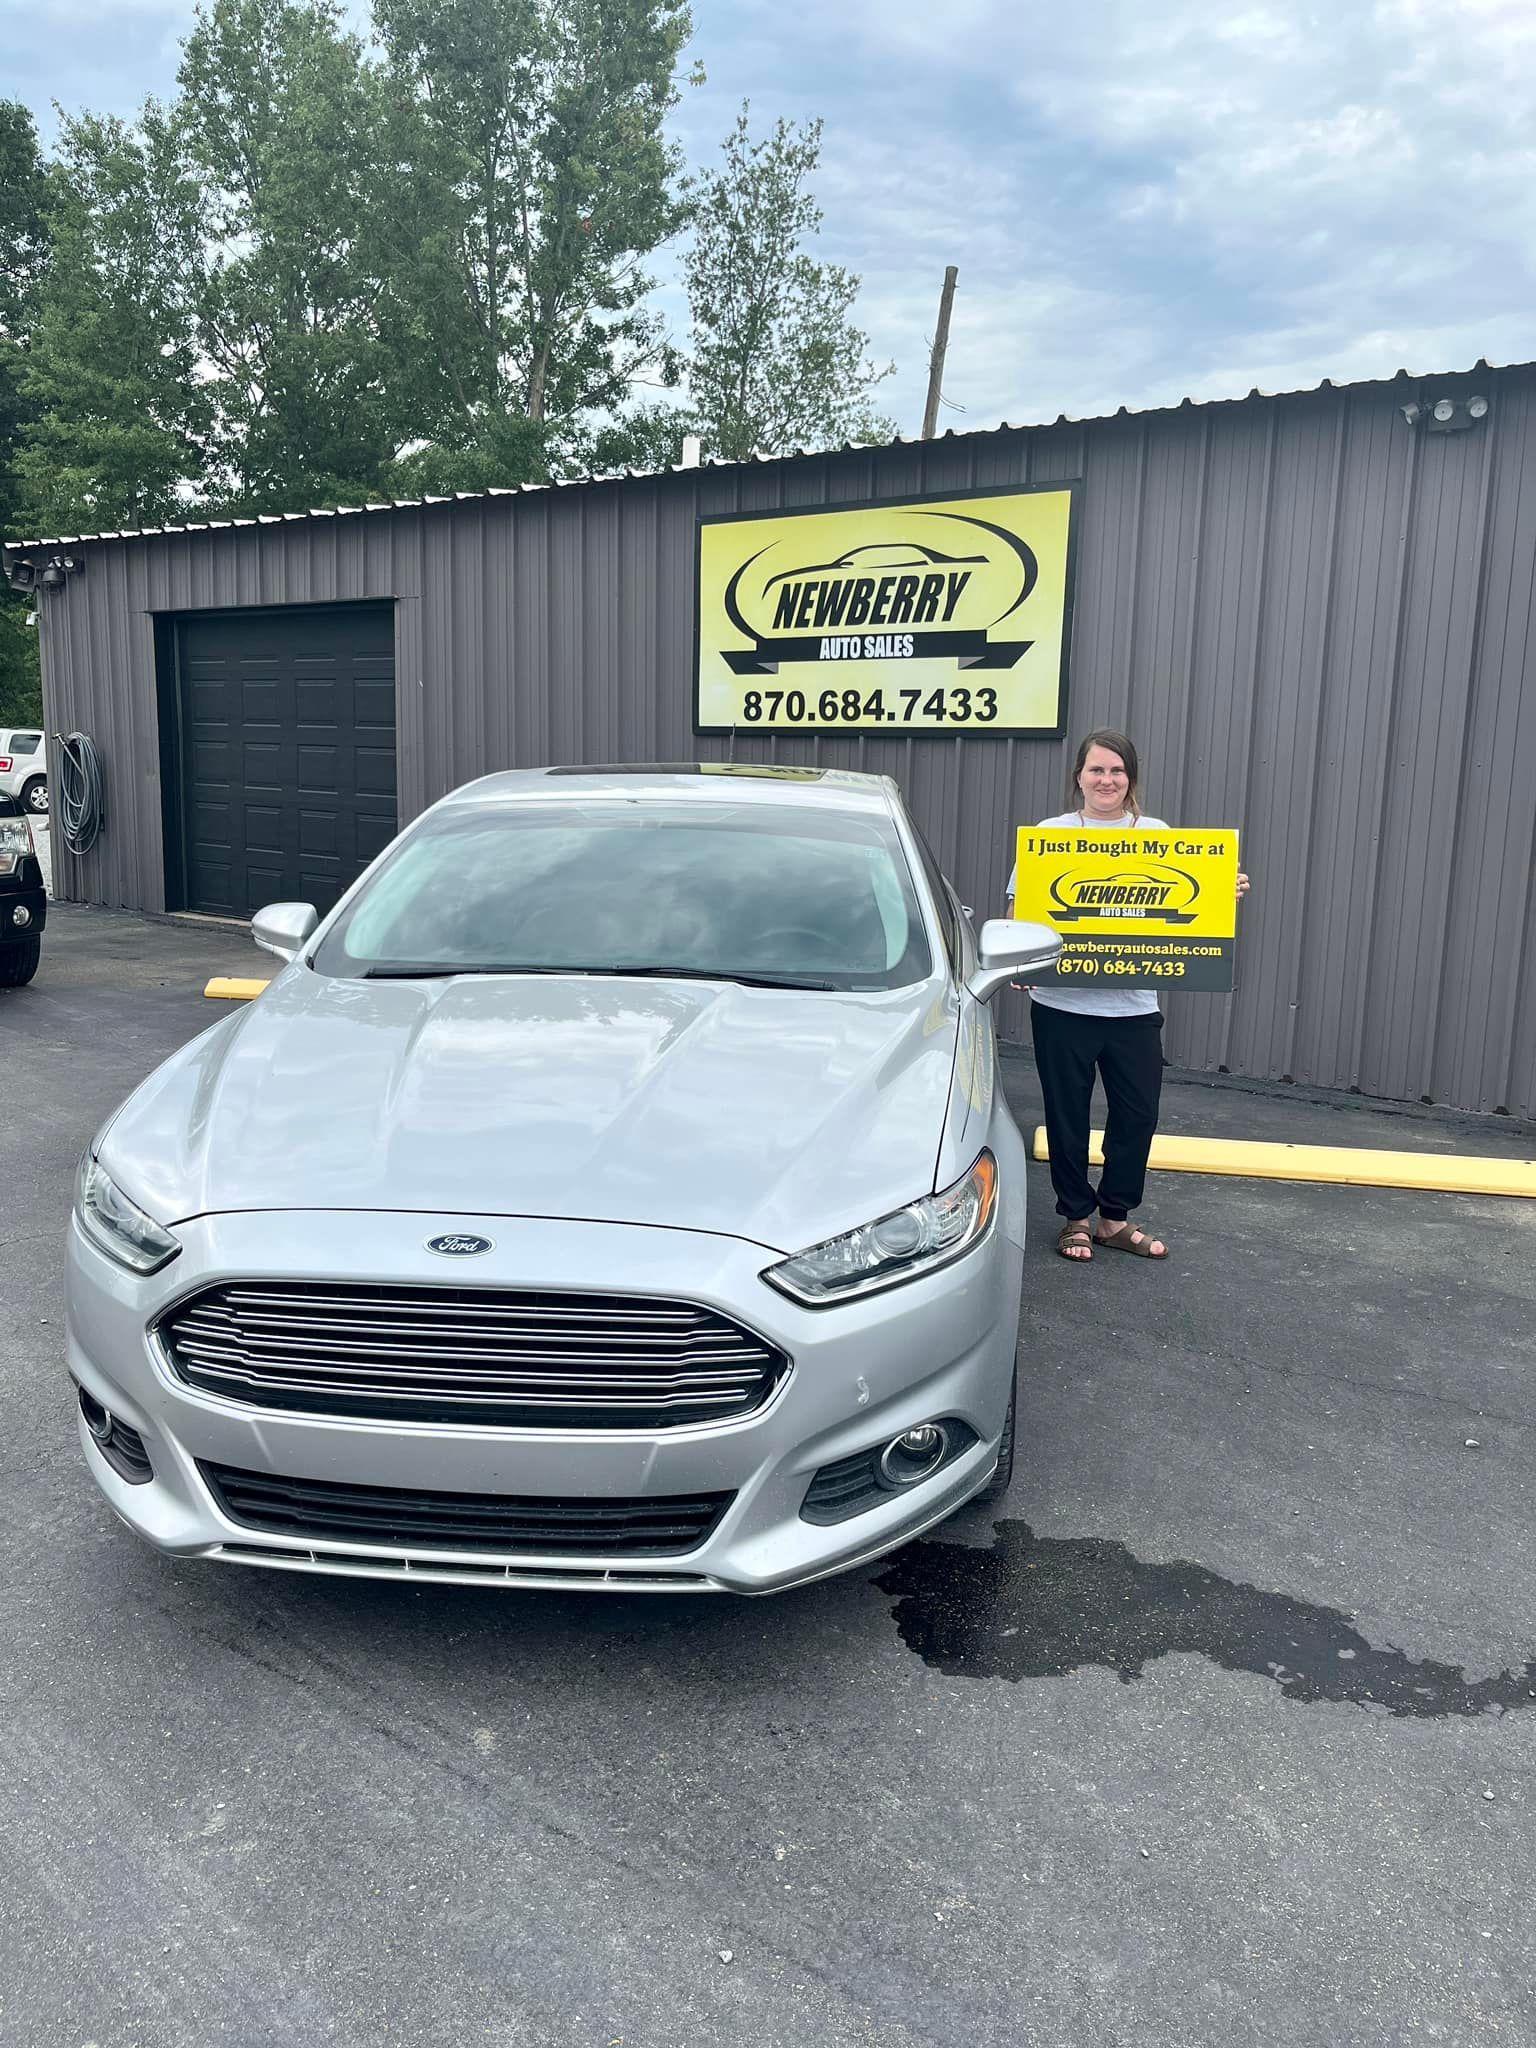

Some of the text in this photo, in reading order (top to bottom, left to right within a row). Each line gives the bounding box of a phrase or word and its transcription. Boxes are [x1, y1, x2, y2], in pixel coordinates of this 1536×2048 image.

[772, 571, 972, 630] NEWBERRY
[819, 635, 914, 659] AUTO SALES
[743, 688, 998, 721] 870.684.7433
[1028, 839, 1225, 858] I Just Bought My Car at
[1075, 885, 1171, 905] NEWBERRY
[1100, 908, 1146, 918] AUTO SALES
[1056, 957, 1185, 976] (870) 684-7433
[438, 1236, 480, 1251] Ford
